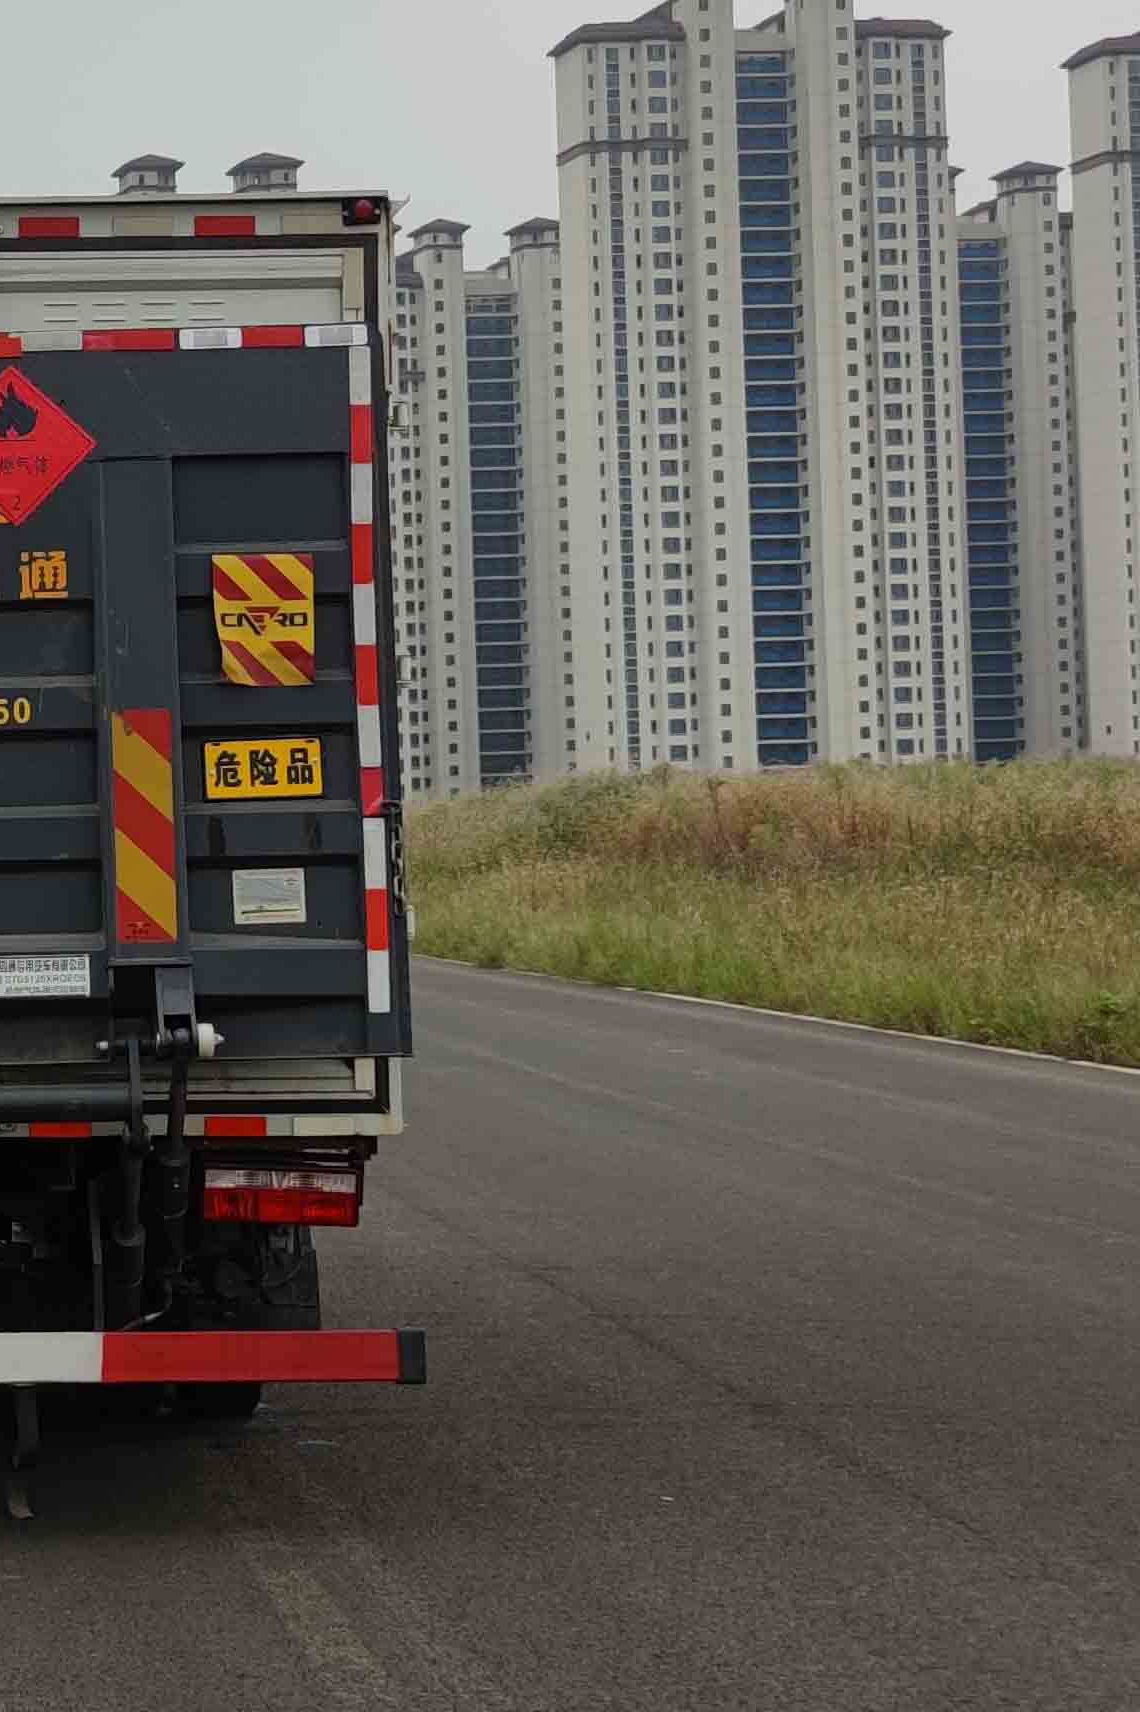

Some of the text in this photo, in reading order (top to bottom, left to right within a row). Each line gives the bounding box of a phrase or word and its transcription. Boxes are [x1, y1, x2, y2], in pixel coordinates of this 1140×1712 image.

[12, 495, 21, 510] 2
[214, 747, 314, 788] 危险品
